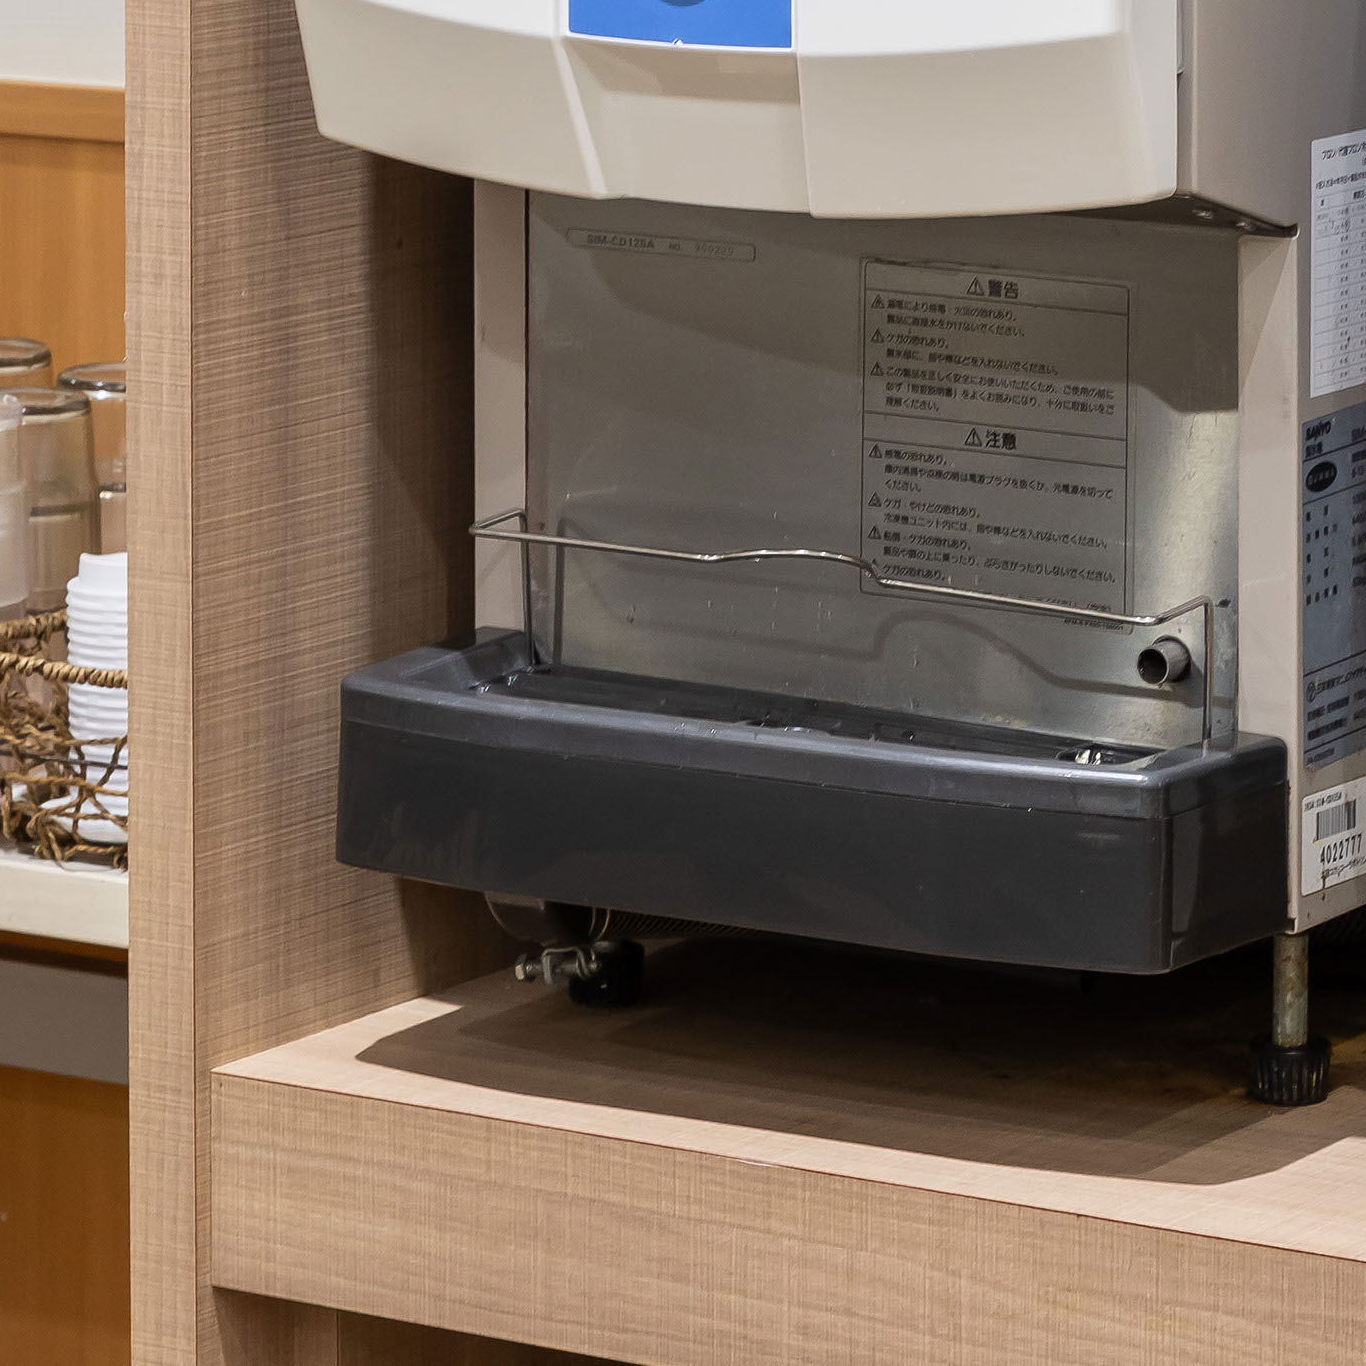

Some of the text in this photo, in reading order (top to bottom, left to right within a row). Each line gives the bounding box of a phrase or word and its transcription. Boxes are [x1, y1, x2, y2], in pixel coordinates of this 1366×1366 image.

[988, 278, 1019, 300] 警告
[985, 430, 1017, 450] 注意
[1320, 833, 1363, 865] 4022777
